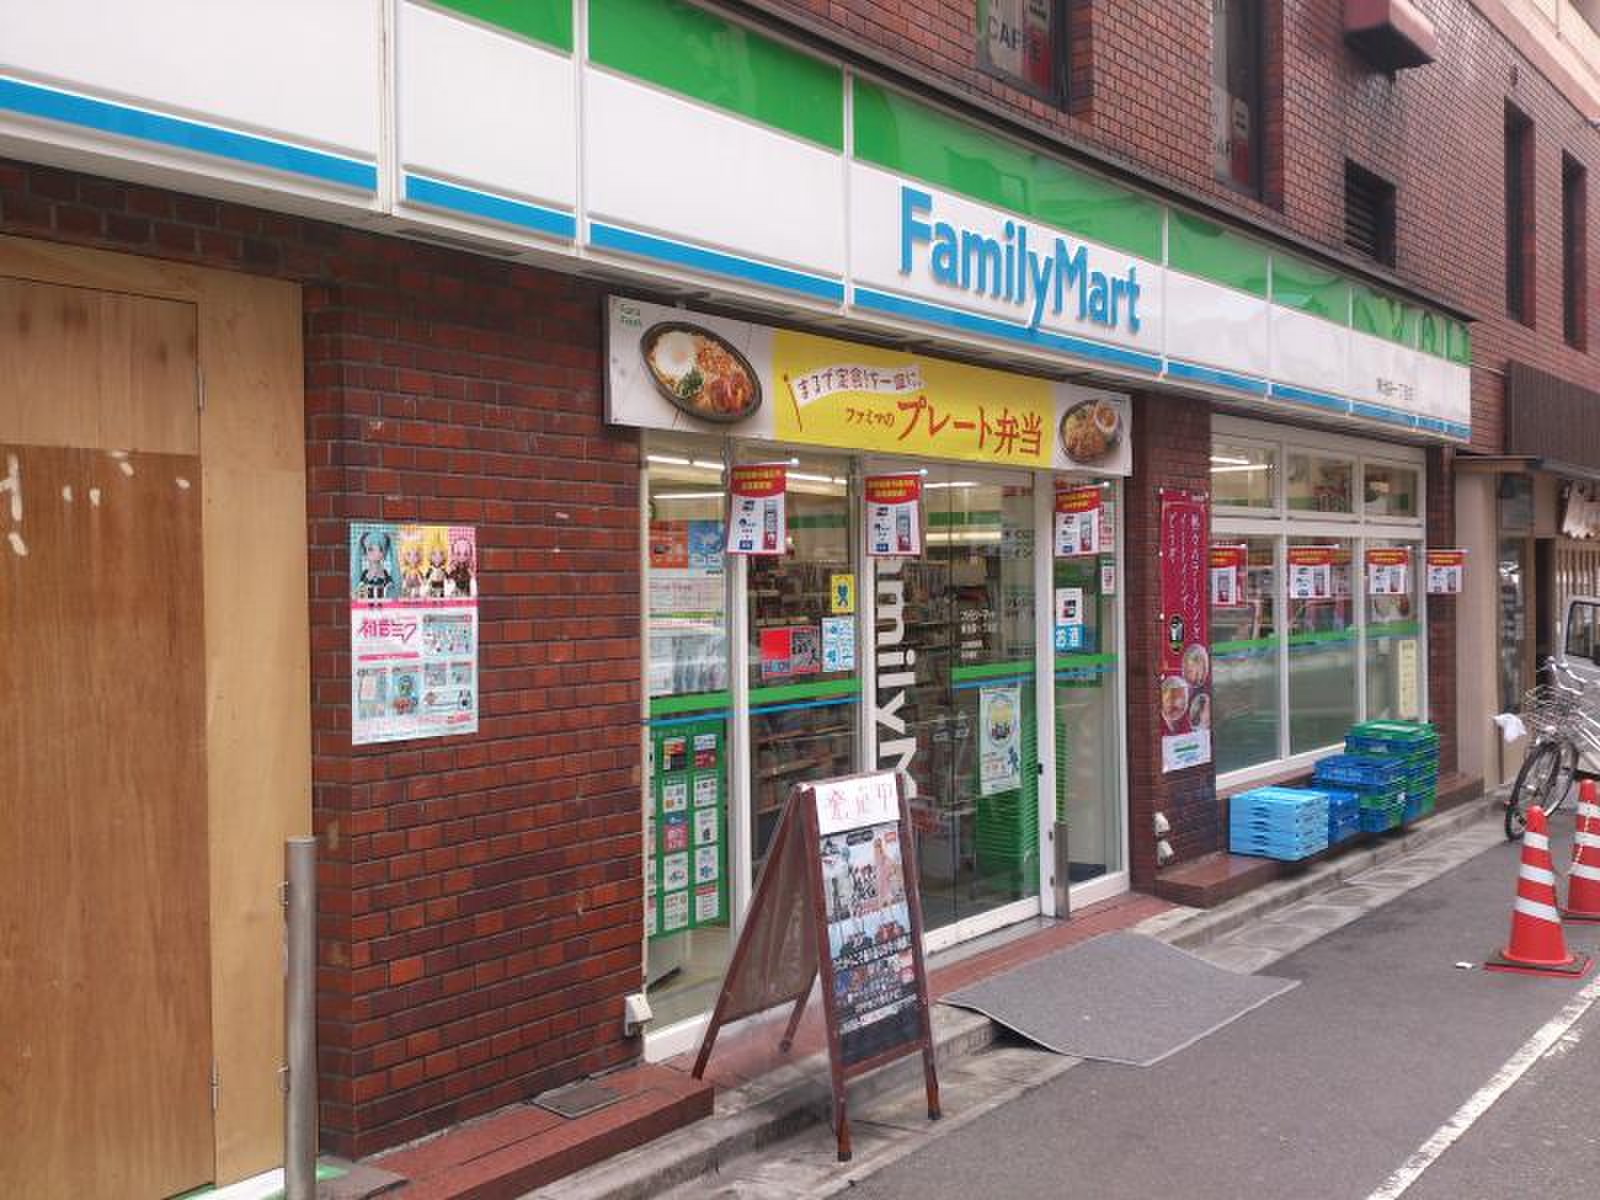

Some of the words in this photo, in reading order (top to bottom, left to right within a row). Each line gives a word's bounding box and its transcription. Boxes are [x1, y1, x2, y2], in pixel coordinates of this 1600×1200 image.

[899, 185, 1140, 334] FamilyMart
[897, 394, 1042, 457] プレート弁当
